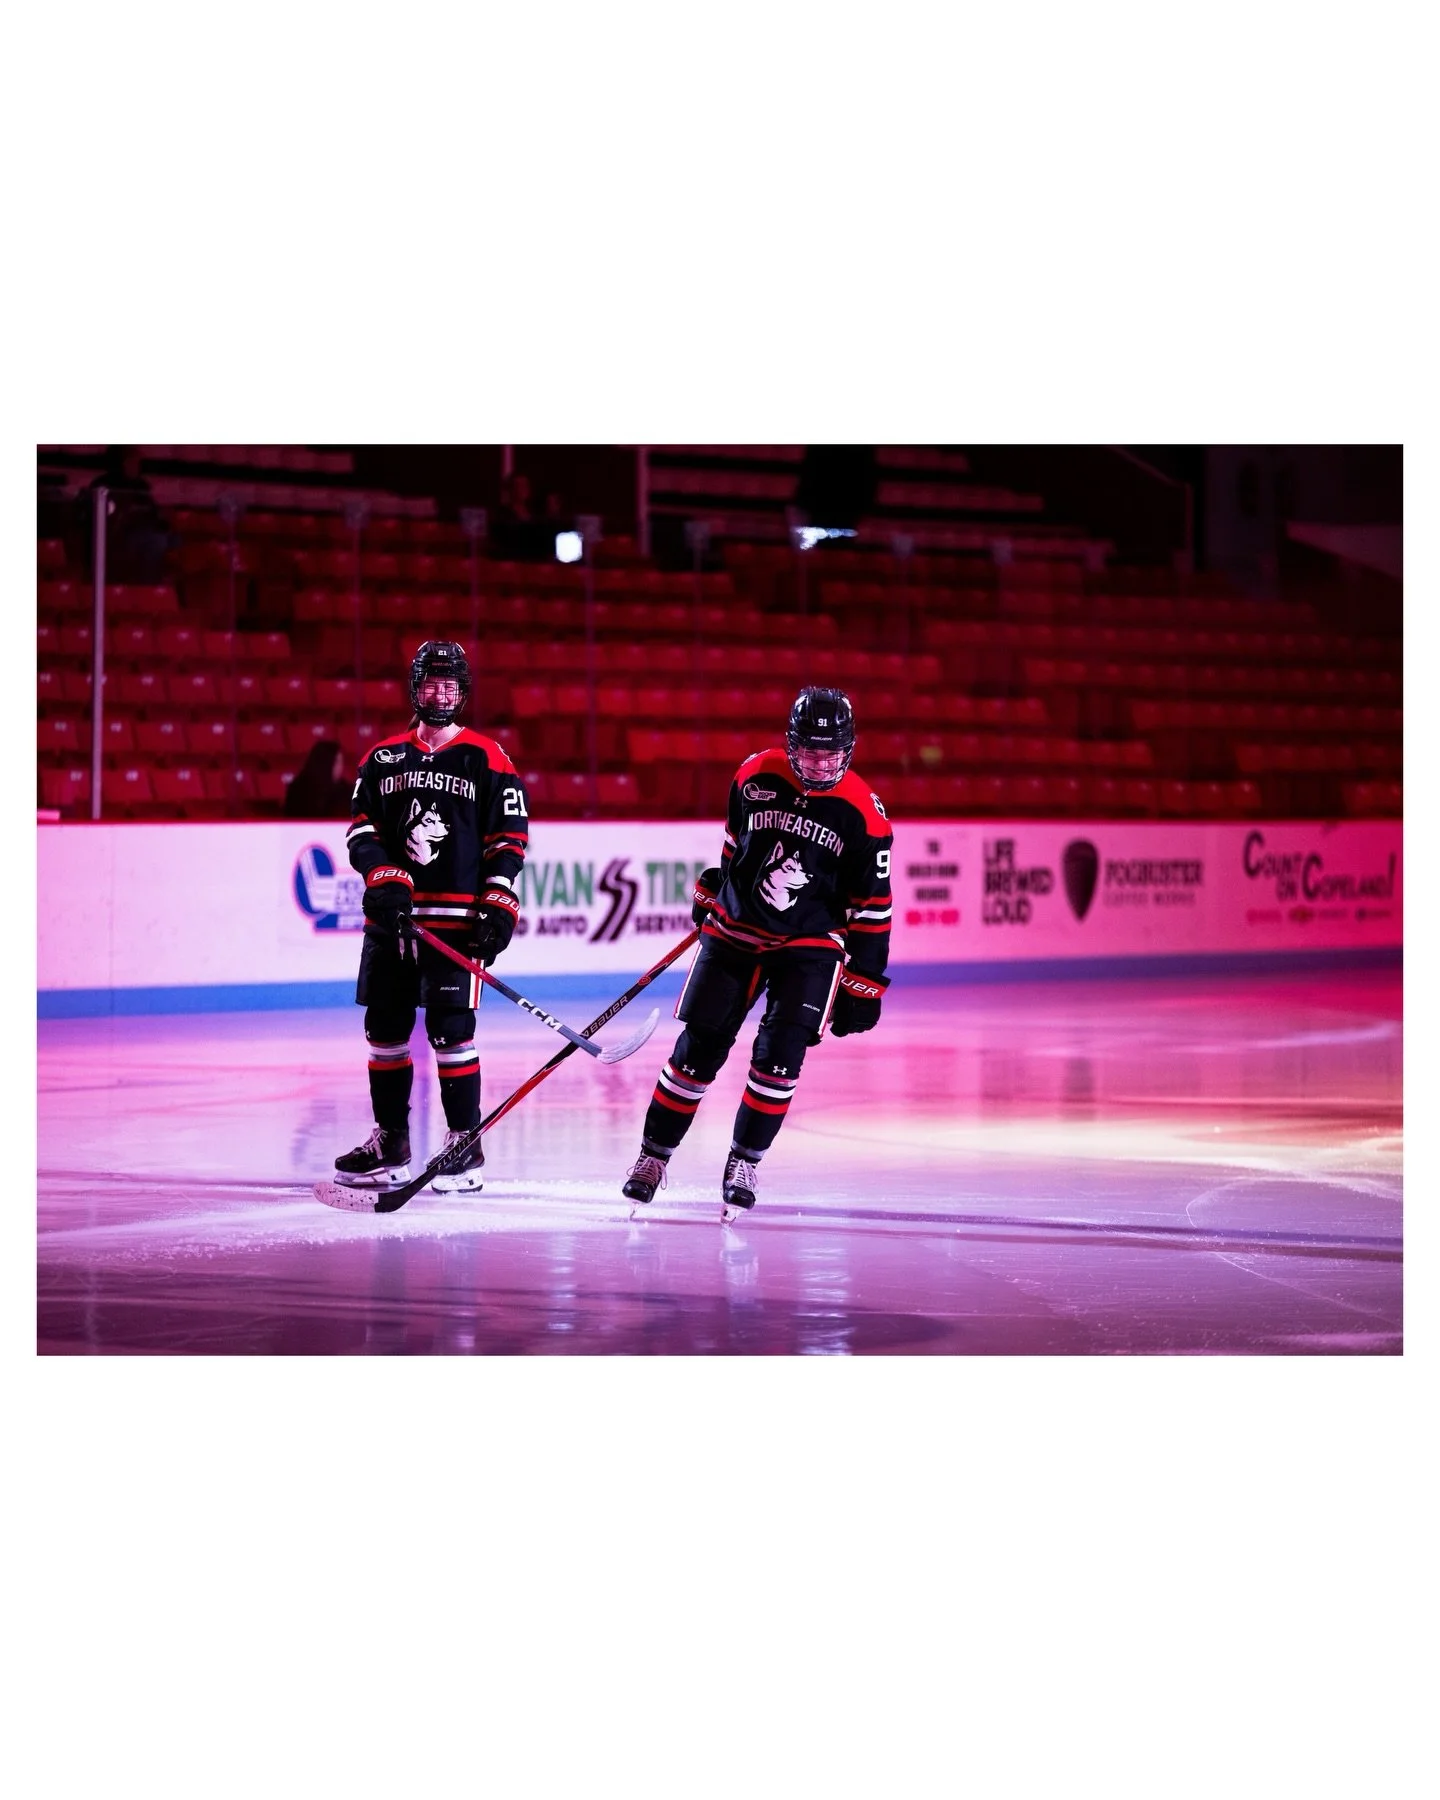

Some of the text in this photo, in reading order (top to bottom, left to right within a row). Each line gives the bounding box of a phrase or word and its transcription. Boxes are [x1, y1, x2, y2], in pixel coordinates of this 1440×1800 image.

[817, 718, 828, 727] 91
[352, 778, 362, 800] 1
[379, 771, 476, 802] NORTHEASTERN
[503, 787, 528, 817] 21
[748, 810, 844, 857] NORTHEASTERN
[876, 849, 891, 879] 9
[1243, 830, 1302, 878] COUNT
[373, 869, 414, 886] BAU
[519, 860, 594, 907] IVAN
[486, 893, 520, 912] BAU
[536, 914, 588, 936] AUTO
[841, 976, 879, 997] UER
[517, 998, 563, 1032] CCM
[590, 995, 629, 1034] BAUER
[437, 1135, 472, 1170] FLYLITE
